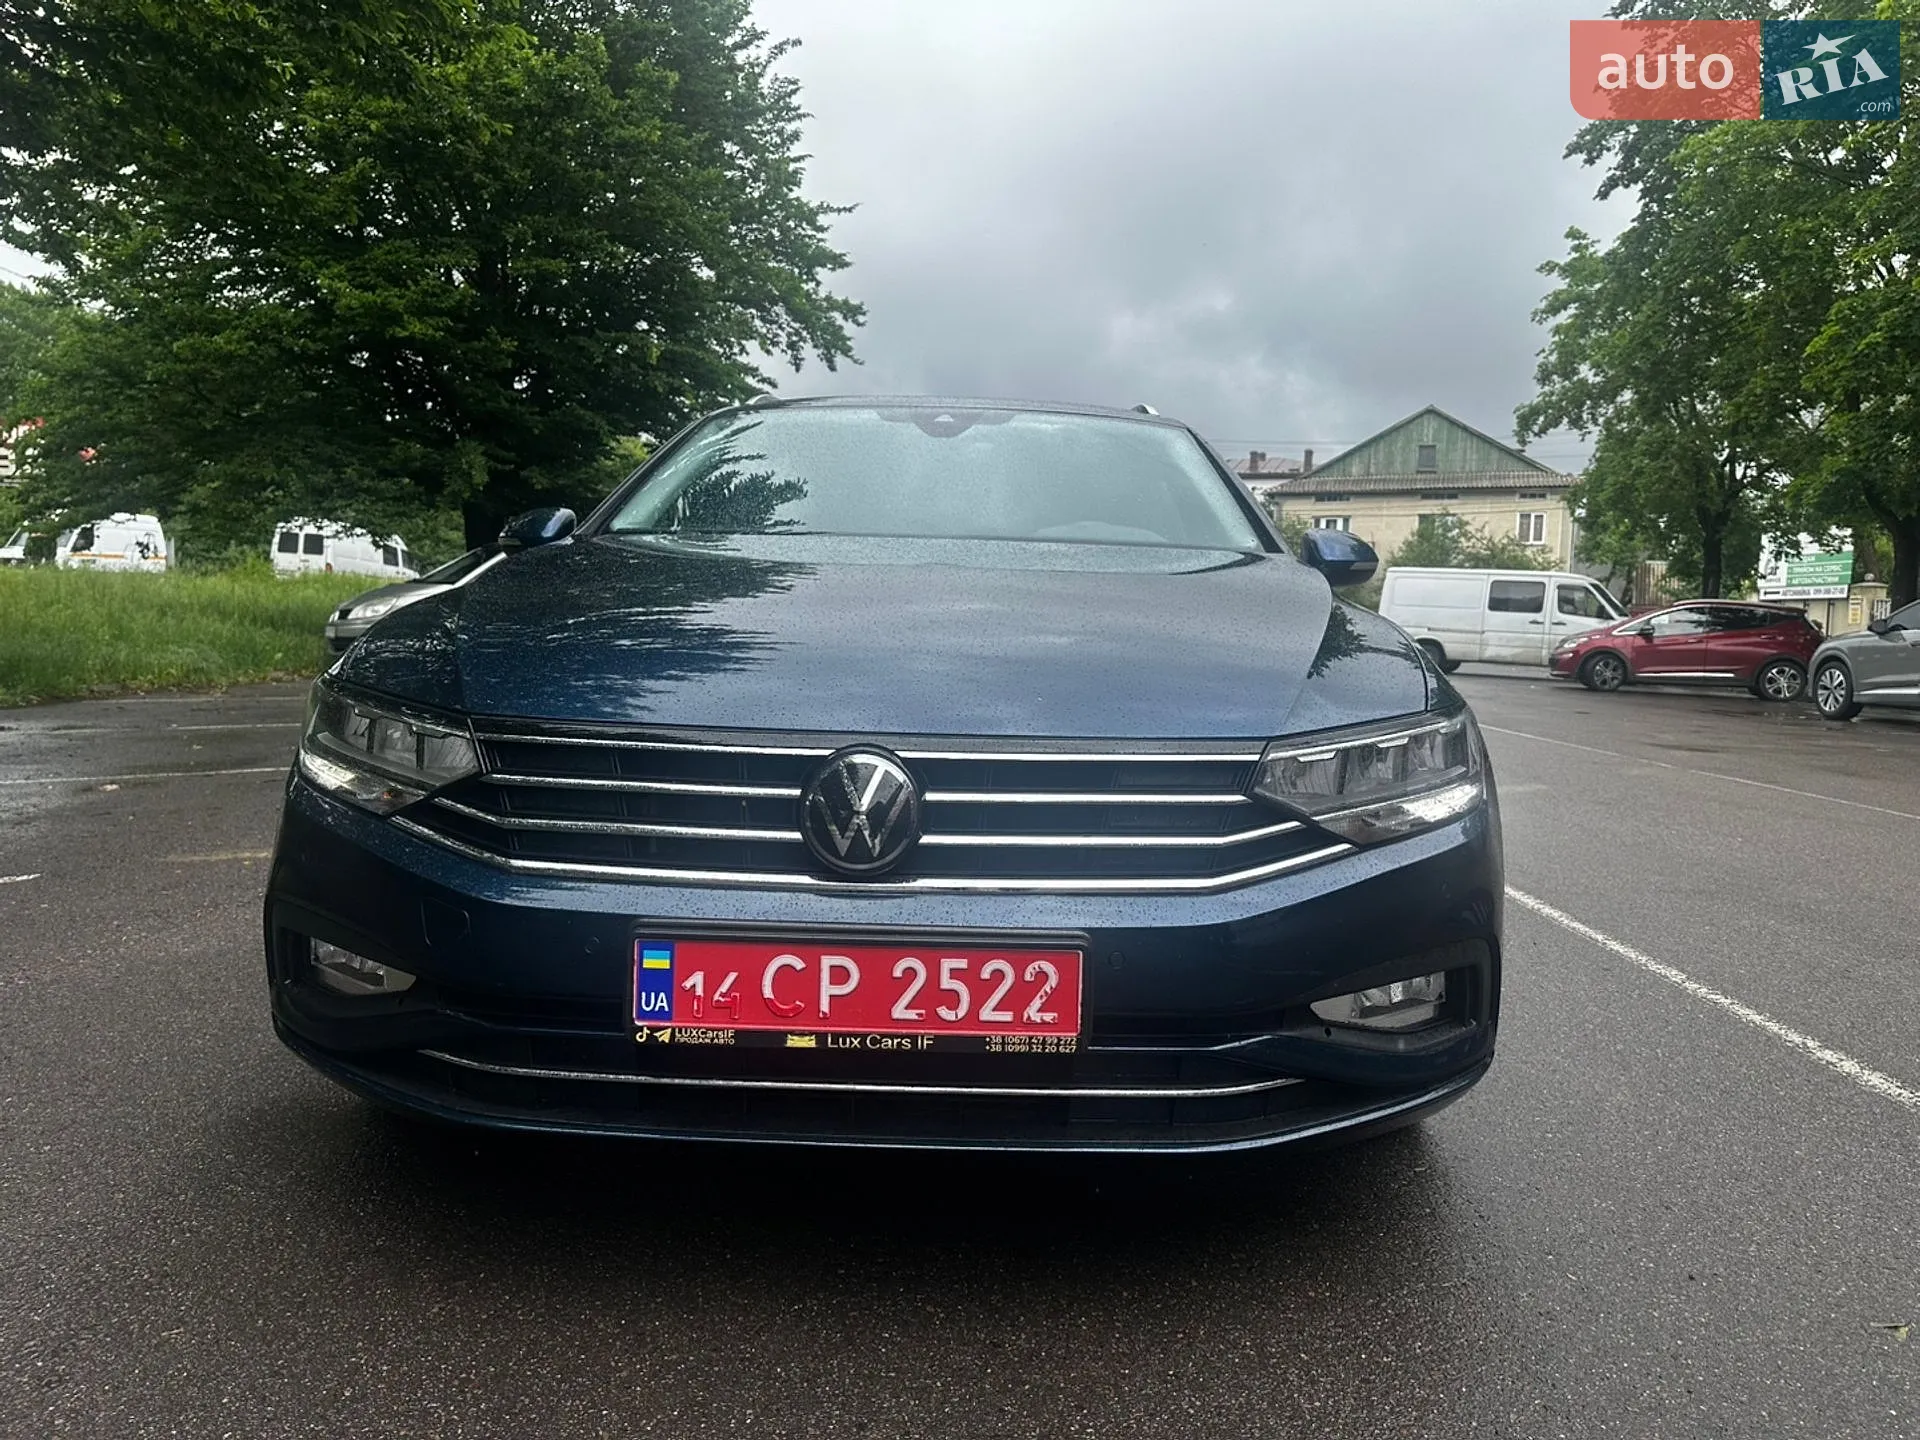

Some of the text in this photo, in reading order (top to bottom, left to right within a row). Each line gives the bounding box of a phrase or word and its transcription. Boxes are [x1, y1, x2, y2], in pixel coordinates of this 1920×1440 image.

[680, 953, 1060, 1023] 14 CP 2522
[641, 991, 669, 1012] UA
[827, 1032, 935, 1050] Lux Cars IF
